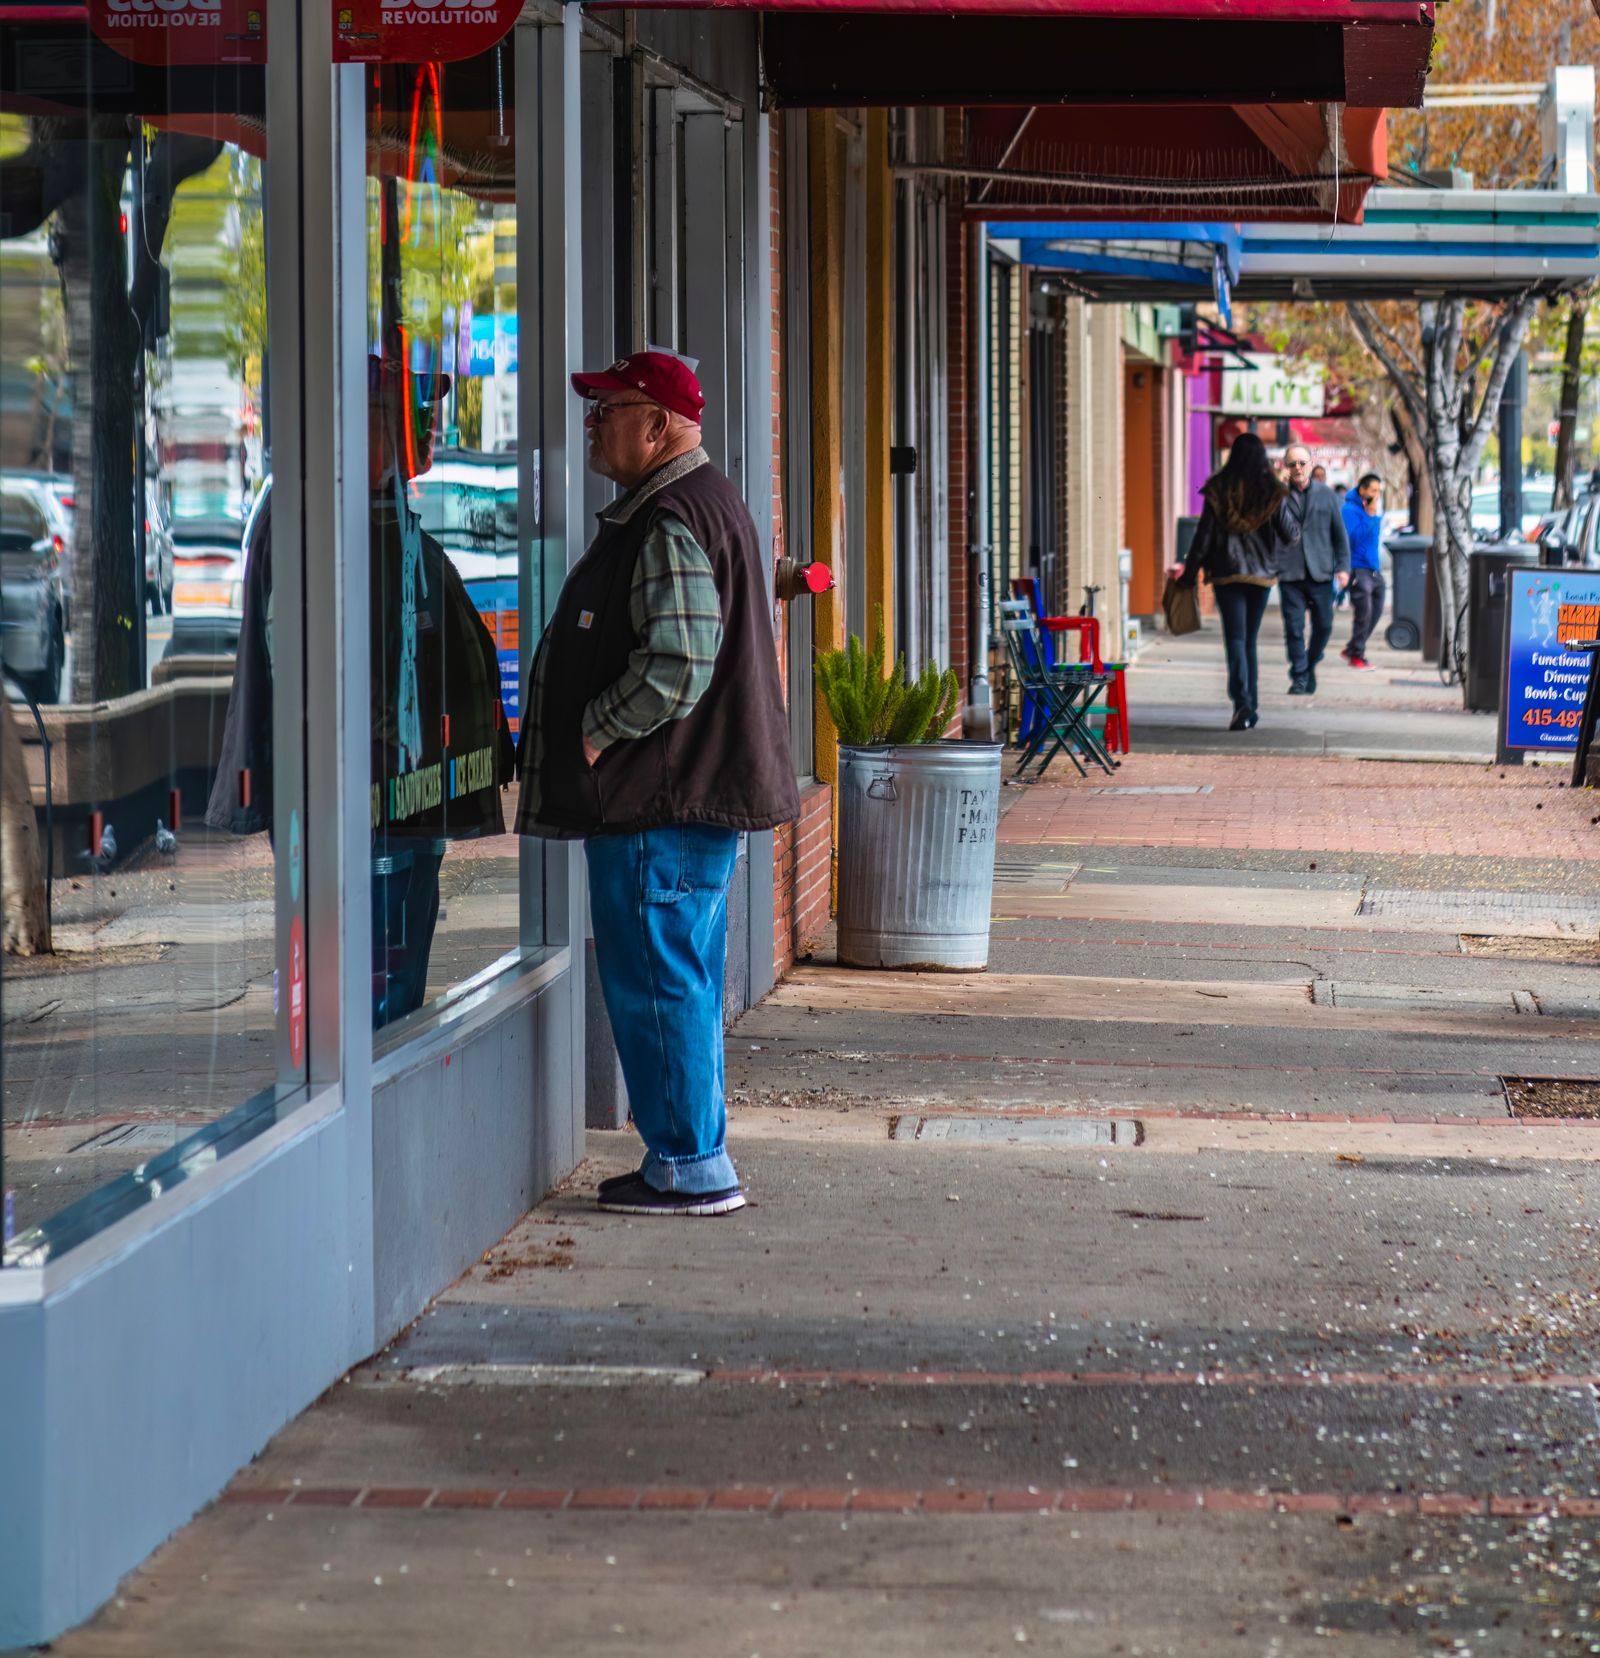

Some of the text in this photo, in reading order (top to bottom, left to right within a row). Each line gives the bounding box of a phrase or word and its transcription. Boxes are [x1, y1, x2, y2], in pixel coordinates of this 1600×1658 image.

[381, 10, 498, 25] REVOLUTION
[1531, 651, 1591, 668] Functional
[1524, 685, 1558, 700] Bowls
[396, 761, 442, 821] SANDWICHES
